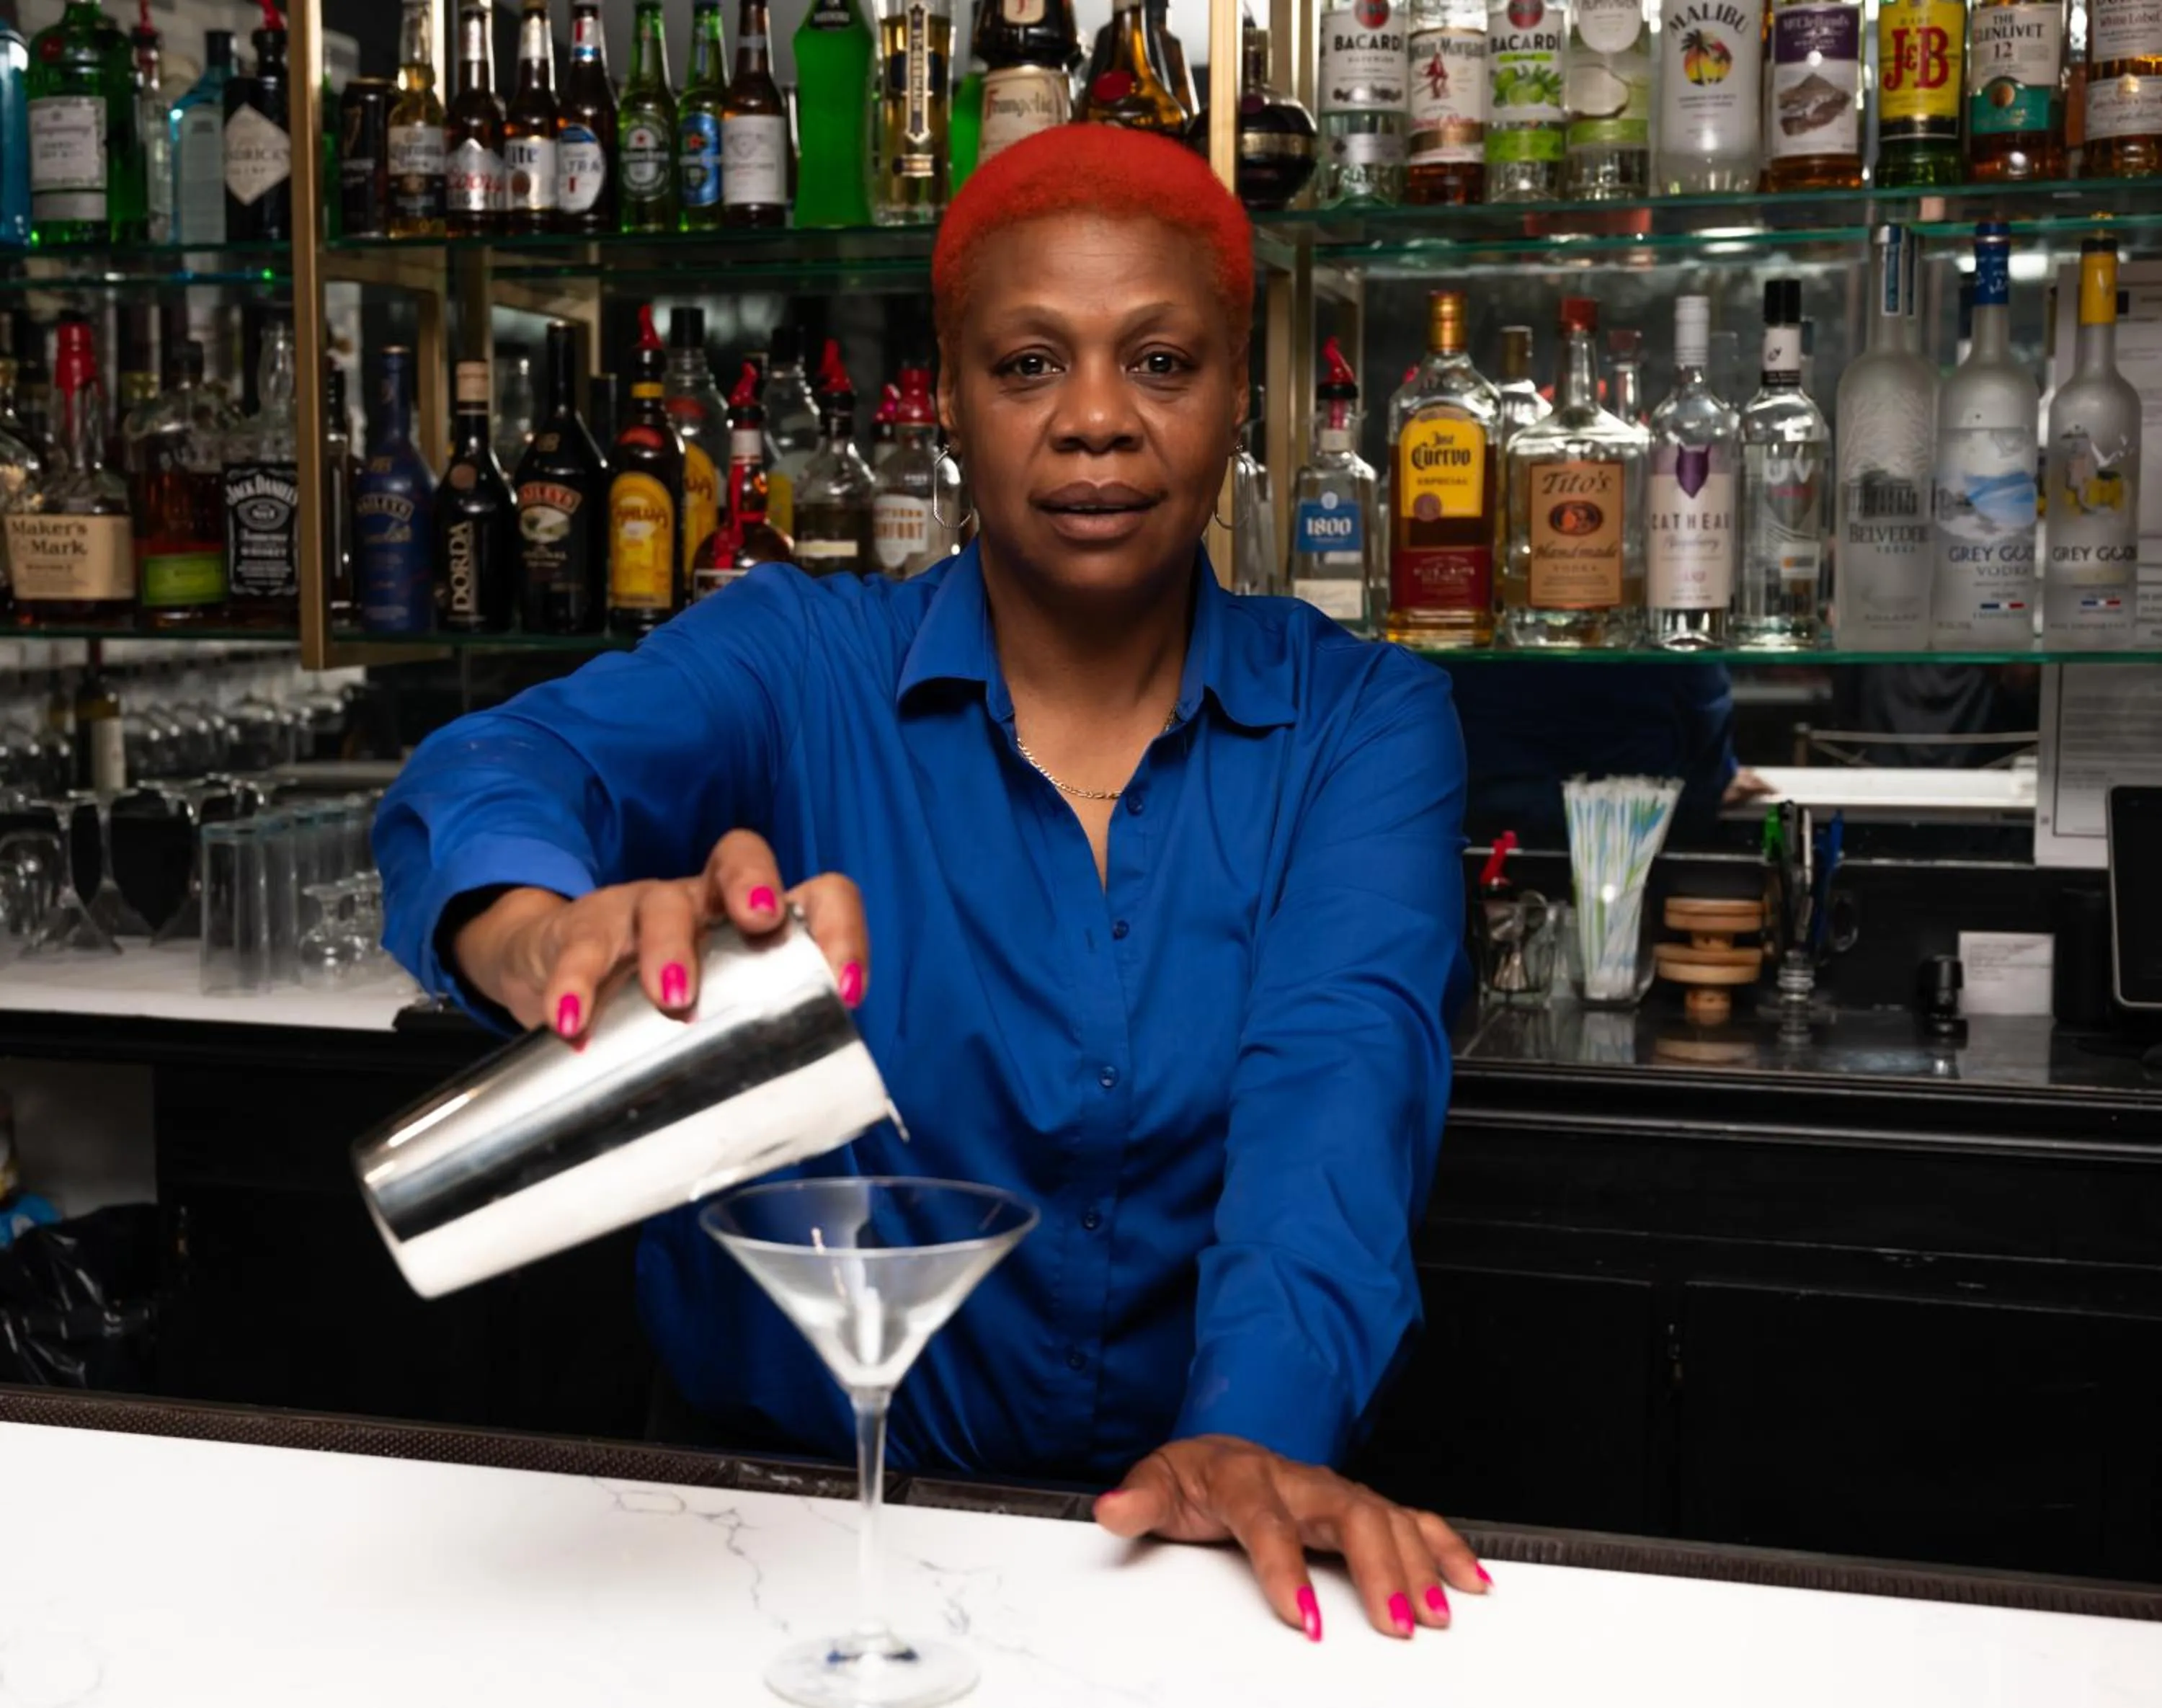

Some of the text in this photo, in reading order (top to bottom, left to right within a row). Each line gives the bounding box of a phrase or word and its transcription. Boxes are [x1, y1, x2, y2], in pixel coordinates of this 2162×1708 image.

[1668, 3, 1749, 37] MALIBU
[1993, 14, 2014, 24] THE
[1994, 41, 2012, 58] 12
[1883, 26, 1949, 92] J&B
[1411, 442, 1472, 471] Cuervo
[1542, 470, 1612, 495] Tito's
[12, 519, 88, 536] Maker's
[1307, 517, 1352, 536] 1800
[32, 539, 89, 556] Mark
[1948, 545, 1994, 563] GREY
[2052, 545, 2092, 562] GREY
[449, 521, 472, 612] DORDA
